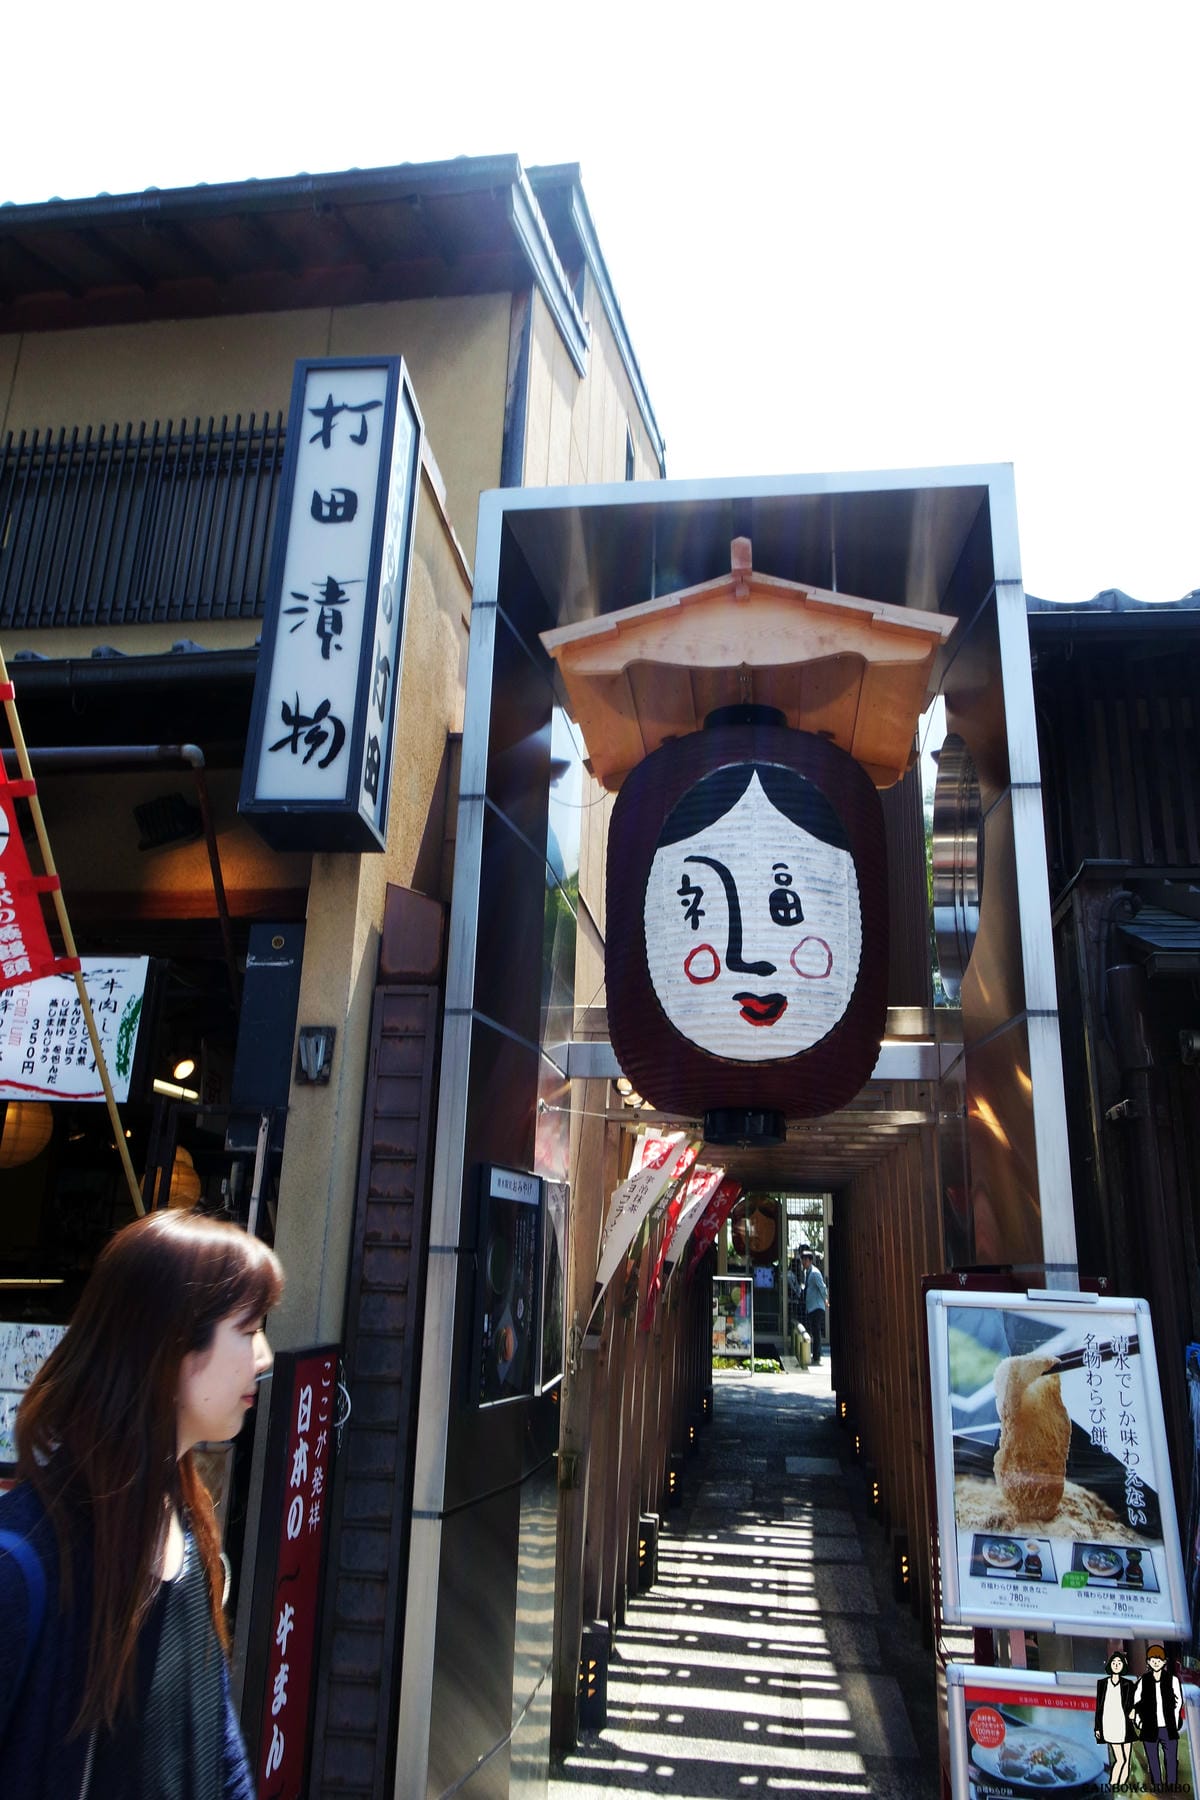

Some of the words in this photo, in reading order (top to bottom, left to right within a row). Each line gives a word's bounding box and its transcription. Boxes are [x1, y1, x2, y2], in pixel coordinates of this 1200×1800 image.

[268, 393, 384, 769] 打田漬物
[21, 1018, 41, 1075] 350円
[308, 1360, 332, 1535] ここが発祥
[1082, 1333, 1110, 1454] 名物わらび餅。
[1111, 1335, 1148, 1527] 清水でしか味わえない
